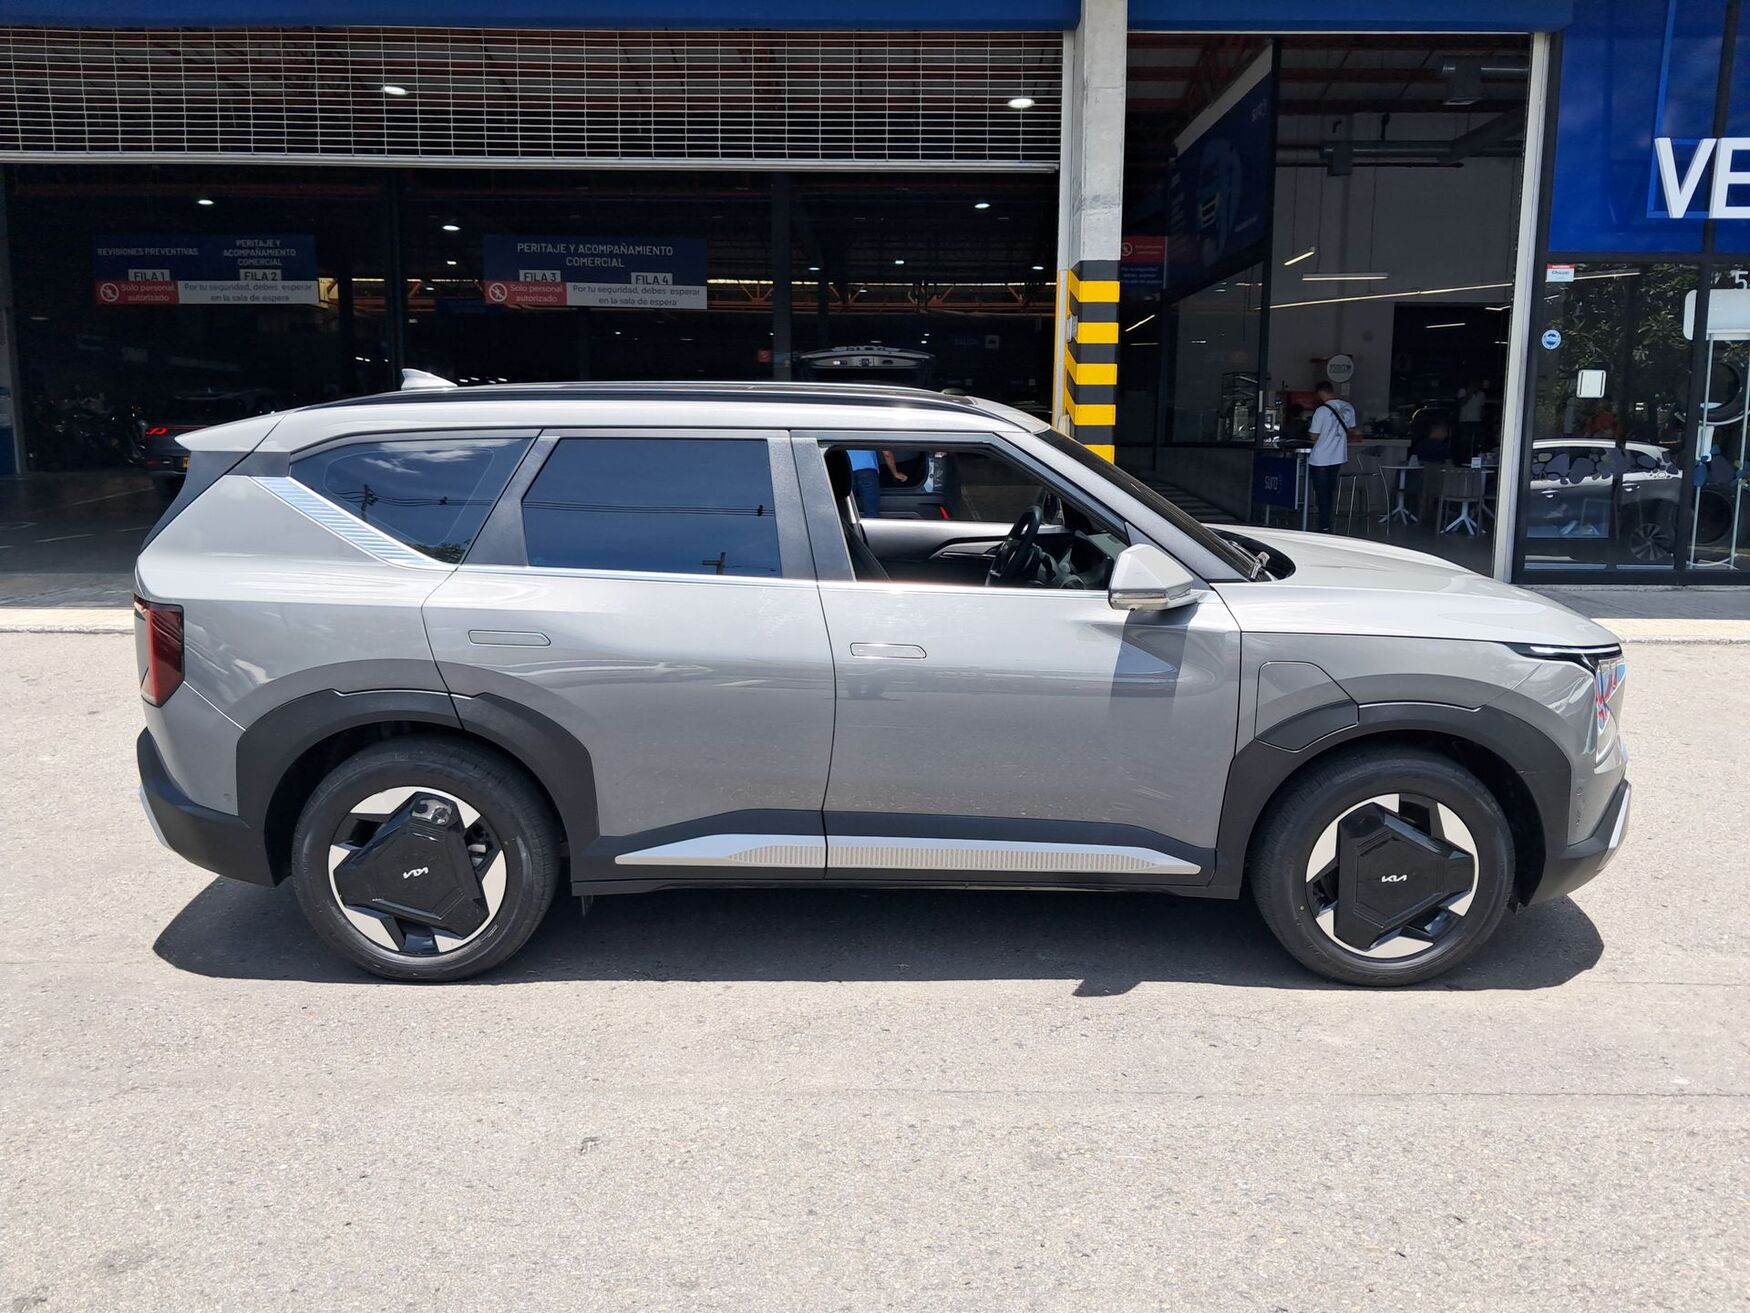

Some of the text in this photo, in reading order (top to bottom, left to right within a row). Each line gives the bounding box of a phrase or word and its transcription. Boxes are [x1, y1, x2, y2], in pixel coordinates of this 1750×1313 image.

[97, 248, 199, 256] REVISIONES PREVENTIVAS
[223, 247, 296, 257] ACOMPAÑAMIENTO
[517, 243, 674, 256] PERITAJE Y ACOMPAÑAMIENTO
[238, 258, 282, 266] COMERCIAL
[565, 257, 624, 268] COMERCIAL
[133, 272, 165, 281] FILA 1
[244, 271, 278, 281] FILA 2
[524, 272, 557, 282] FILA 3
[635, 275, 669, 285] FILA 4
[121, 283, 176, 292] Solo personal
[184, 283, 197, 291] Por
[199, 283, 207, 291] tu
[253, 283, 278, 291] debes
[281, 284, 312, 292] esperar
[510, 284, 563, 293] Solo personal
[573, 285, 700, 297] Por tu seguridad, debes esperar
[128, 294, 170, 302] autorizado
[223, 294, 230, 302] la
[231, 294, 248, 302] sala
[249, 294, 260, 302] de
[262, 295, 290, 303] espera
[516, 295, 558, 303] autorizado
[619, 297, 635, 305] sala
[637, 297, 648, 306] de
[649, 299, 677, 307] espera
